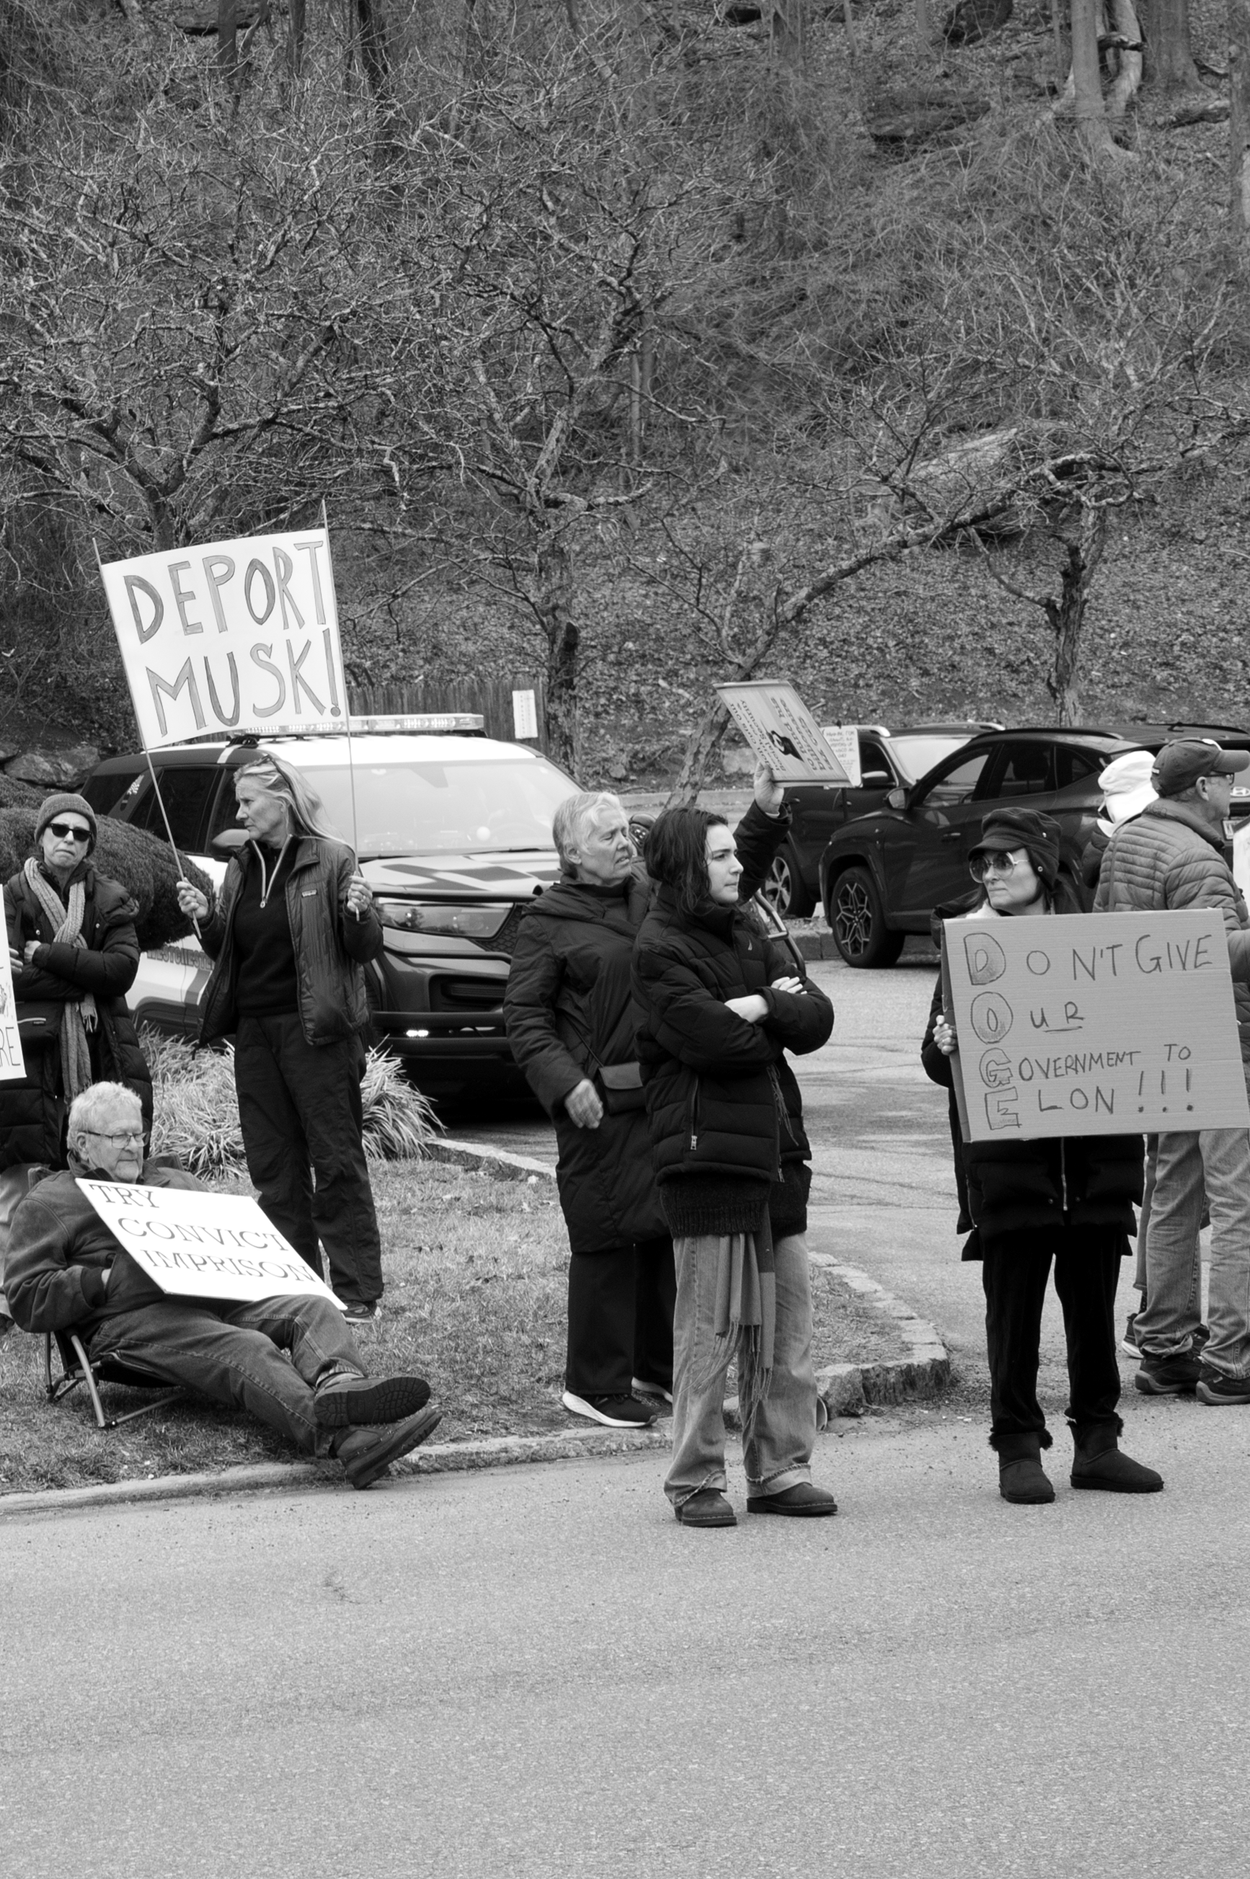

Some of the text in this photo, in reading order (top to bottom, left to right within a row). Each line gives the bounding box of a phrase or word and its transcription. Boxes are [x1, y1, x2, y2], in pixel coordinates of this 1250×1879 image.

[123, 540, 327, 645] DEPORT
[145, 627, 341, 738] MUSK!
[963, 932, 1212, 985] DON'T GIVE
[979, 1044, 1191, 1088] GOVERNMENT TO
[89, 1184, 160, 1208] TRY
[117, 1217, 290, 1251] CONVICT
[140, 1249, 316, 1283] IMPRISON
